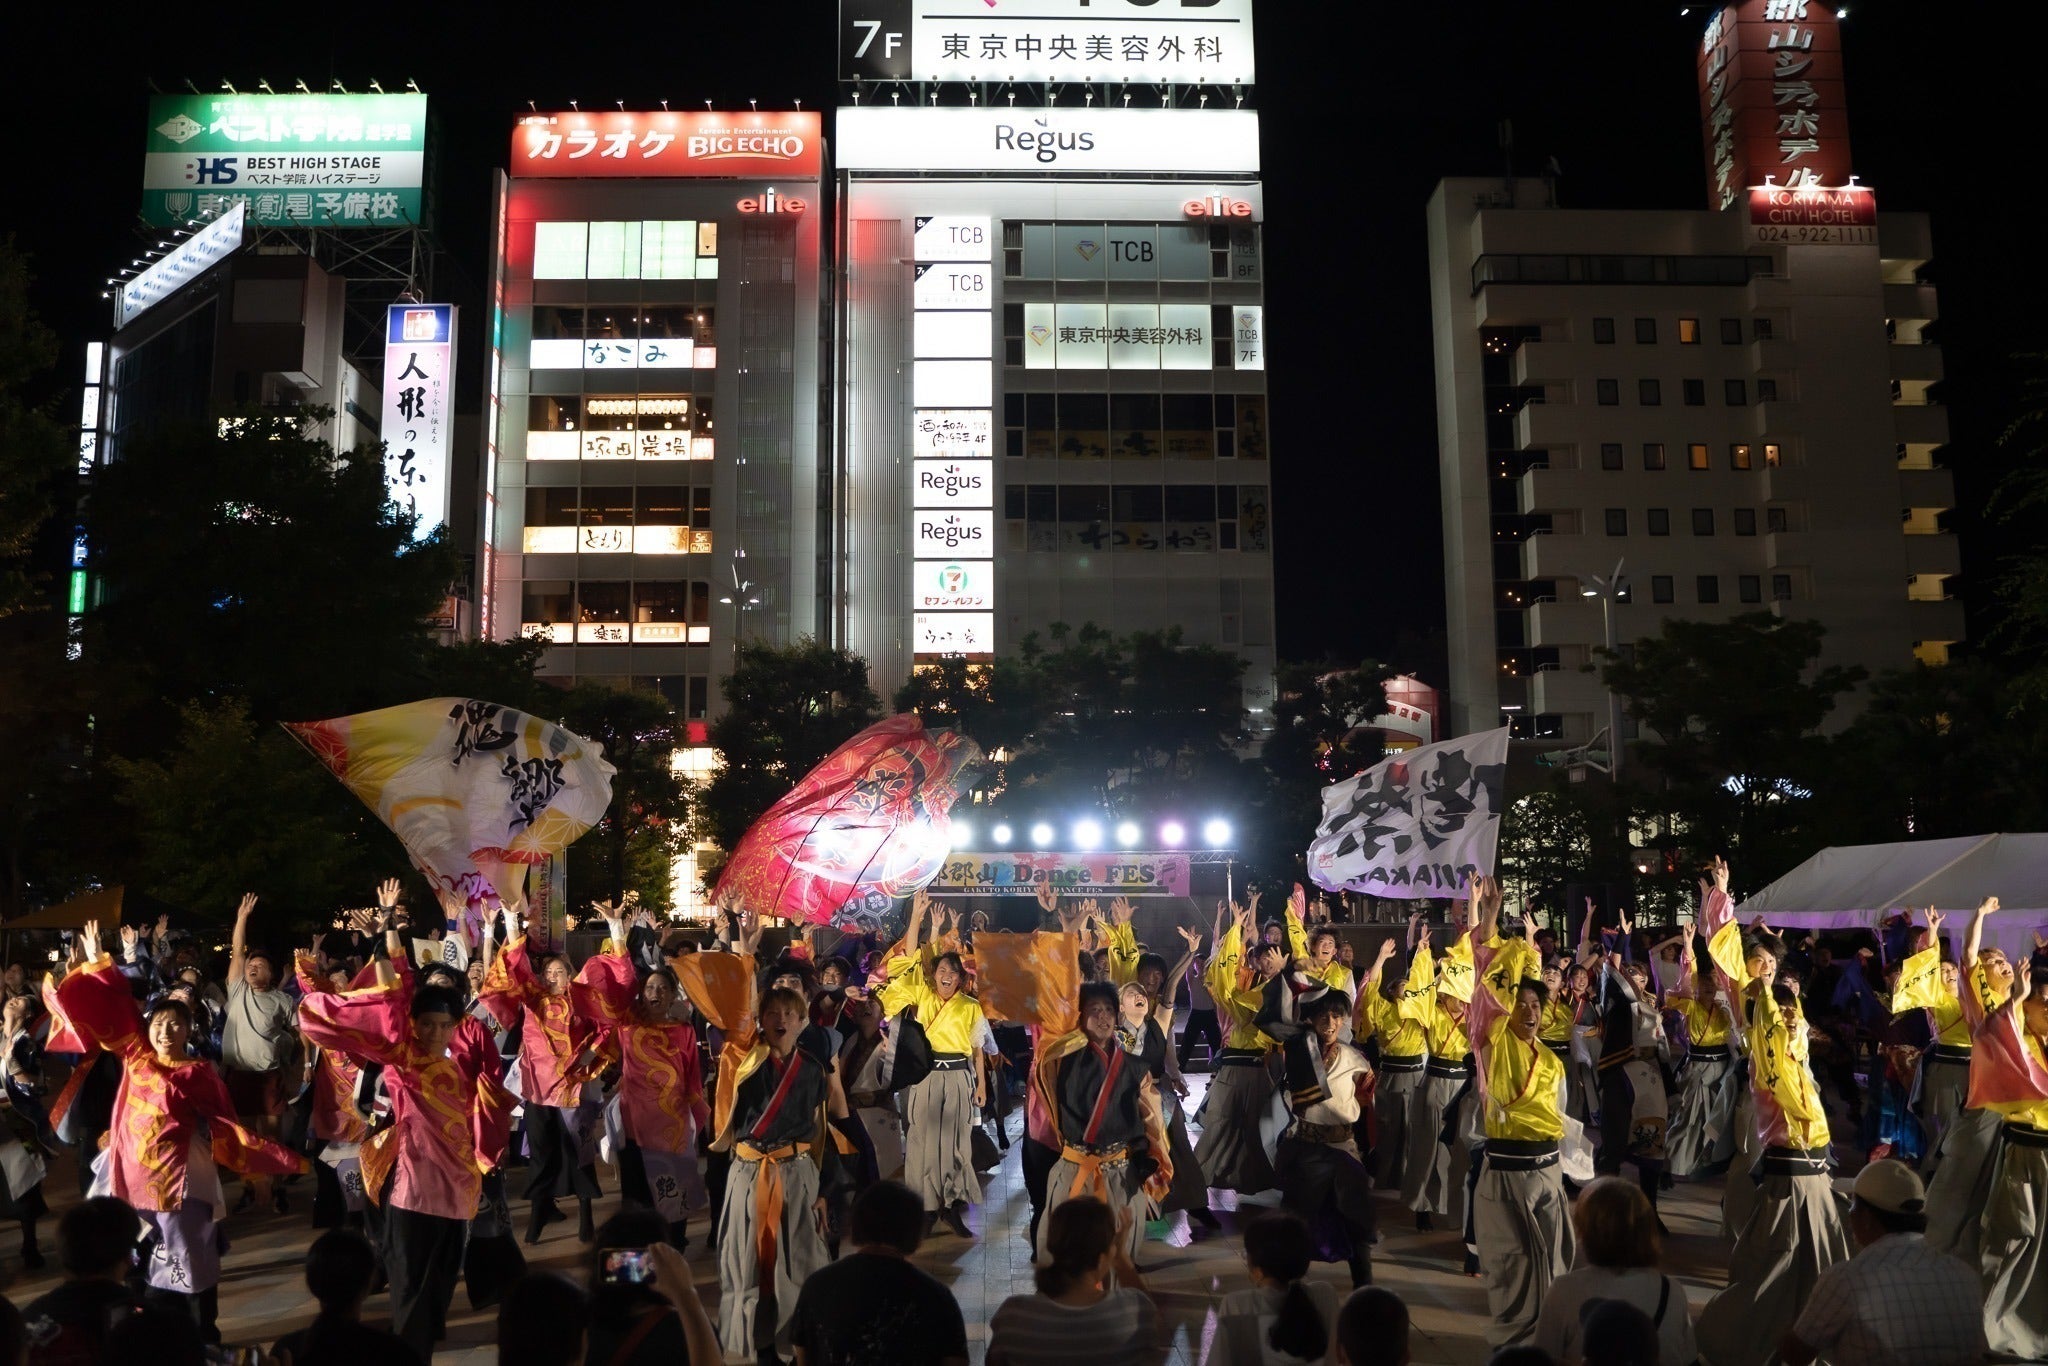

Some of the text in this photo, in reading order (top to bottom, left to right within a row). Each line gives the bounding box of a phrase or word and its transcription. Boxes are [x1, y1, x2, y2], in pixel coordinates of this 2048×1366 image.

[853, 20, 903, 59] 7F
[941, 33, 1223, 63] 東京中央美容外科
[734, 127, 792, 135] Entertainment
[527, 129, 675, 159] カラオケ
[687, 135, 804, 158] BIG ECHO
[995, 124, 1094, 163] Regus
[247, 157, 381, 169] BEST HIGH STAGE
[247, 174, 381, 185] ベスト学院 ハイステージ
[736, 187, 806, 213] elite
[1184, 190, 1252, 217] elite
[1768, 191, 1854, 206] KORIYAMA
[1769, 209, 1858, 224] CITY HOTEL
[948, 226, 984, 244] TCB
[1758, 227, 1874, 242] 024-922-1111
[1110, 241, 1154, 262] TCB
[1238, 265, 1255, 277] 8F
[948, 274, 984, 292] TCB
[1059, 327, 1202, 346] 東京中央美容外科
[1238, 329, 1258, 340] TCB
[1240, 350, 1257, 362] 7F
[974, 434, 987, 443] 4F
[921, 472, 982, 497] Regus
[921, 522, 982, 547] Regus
[524, 625, 537, 634] 4F
[1013, 863, 1091, 883] Dance
[1104, 864, 1155, 884] FES
